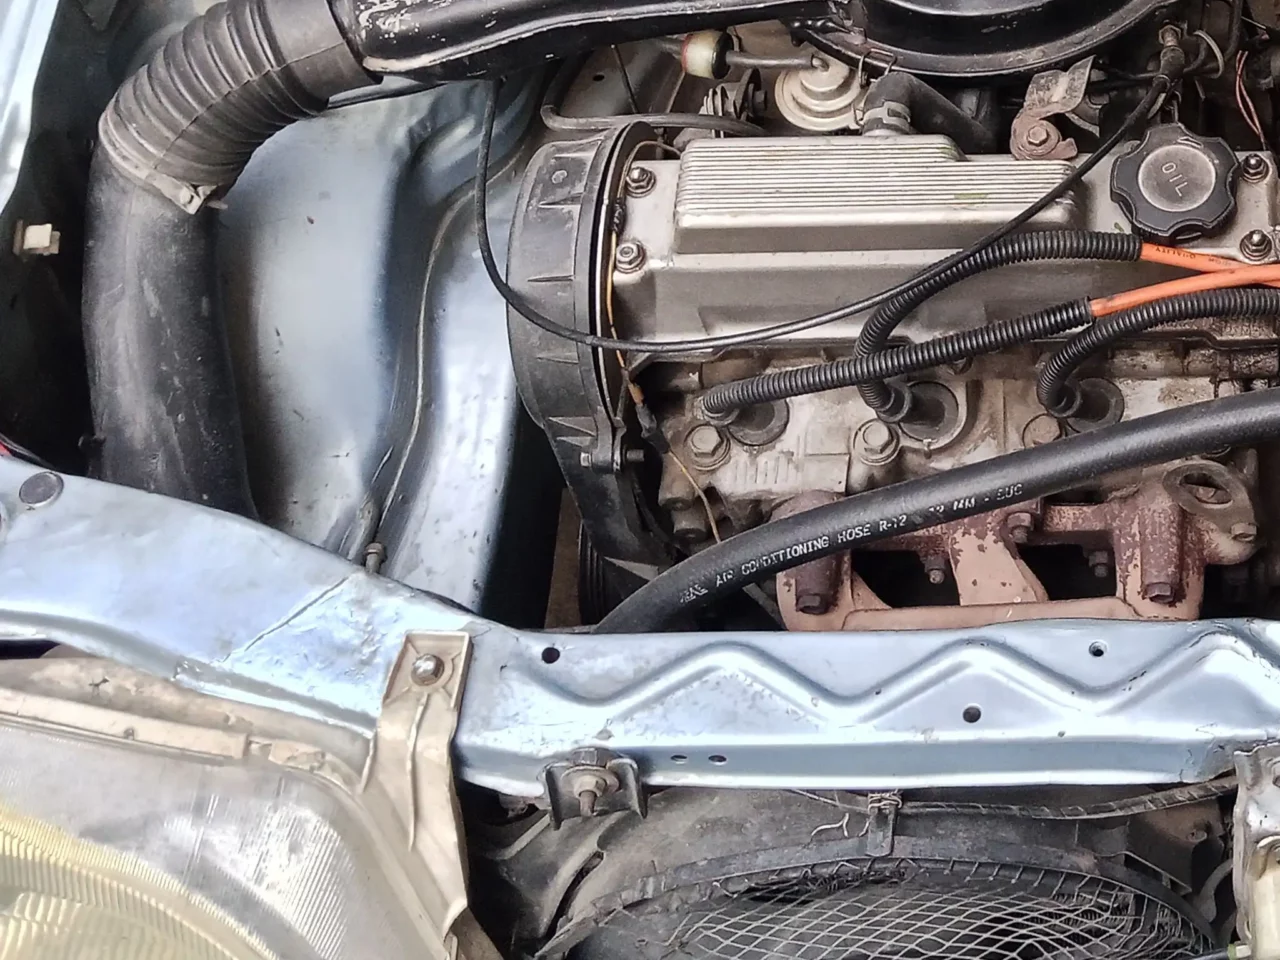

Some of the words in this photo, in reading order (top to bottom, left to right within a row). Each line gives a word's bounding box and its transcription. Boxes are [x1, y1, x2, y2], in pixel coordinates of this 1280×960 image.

[1161, 161, 1188, 198] OIL
[1154, 246, 1196, 260] QUALITY
[715, 569, 735, 588] AIR
[740, 535, 830, 576] CONDITIONING
[836, 523, 872, 544] HOSE
